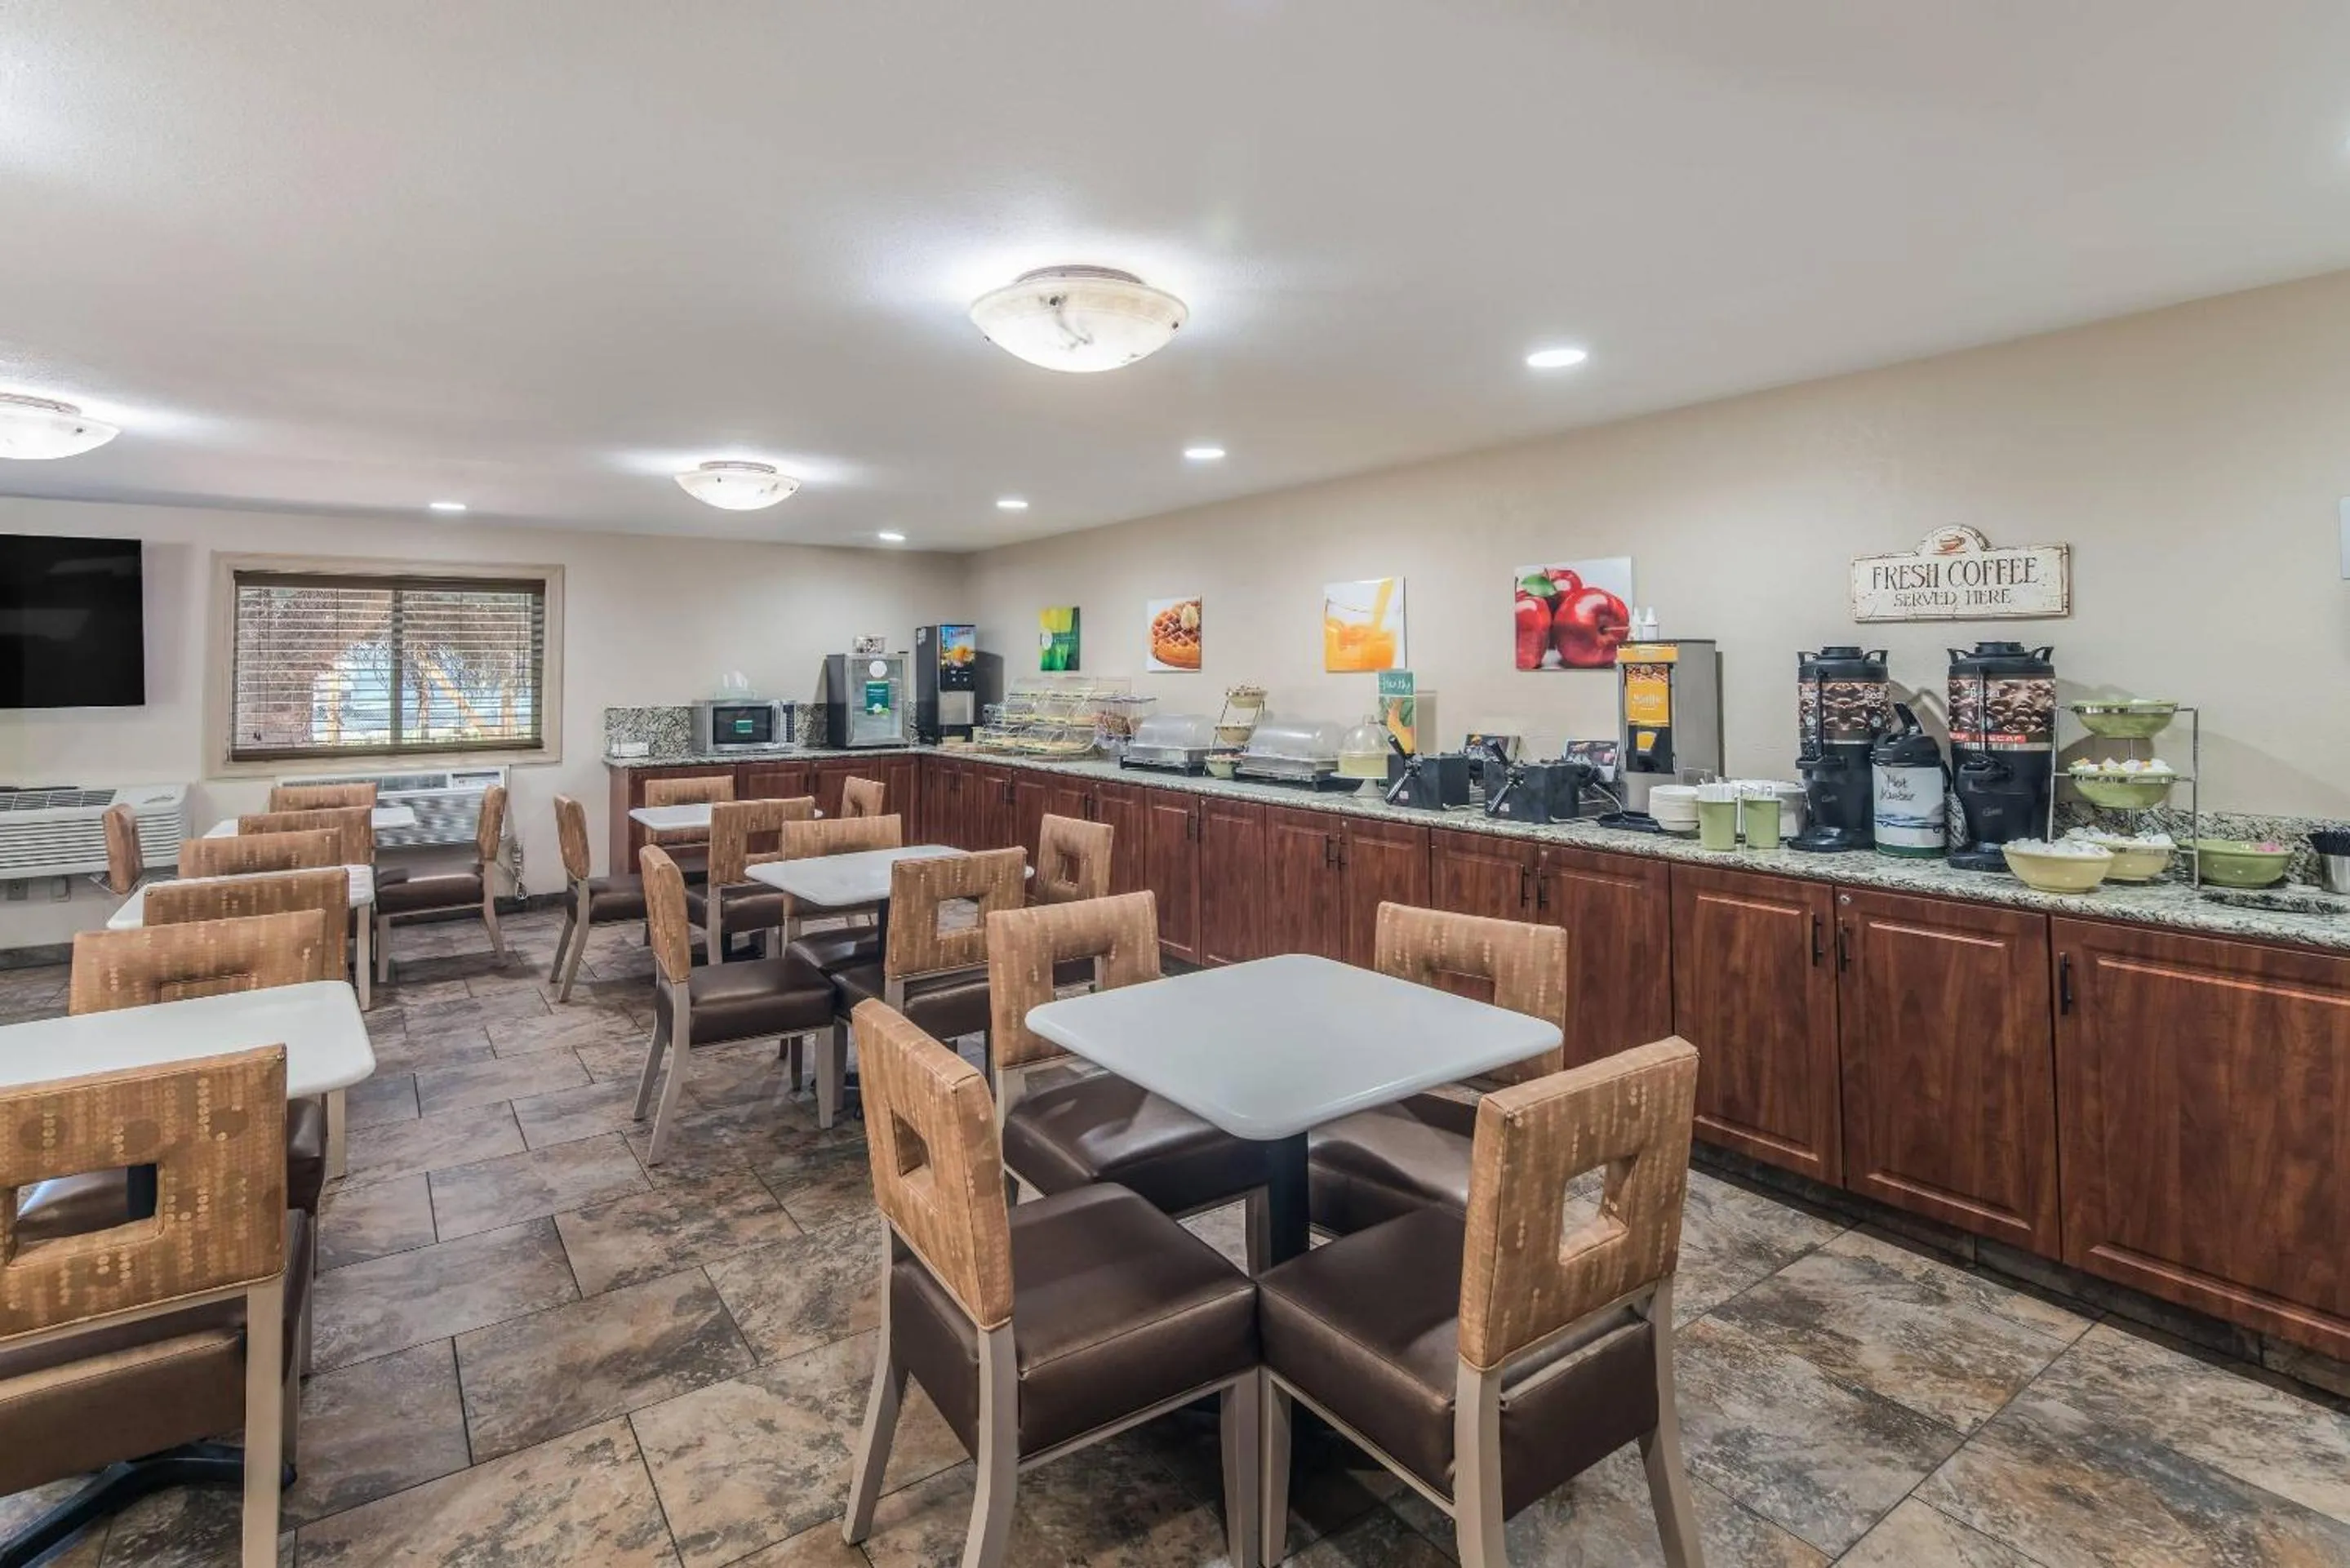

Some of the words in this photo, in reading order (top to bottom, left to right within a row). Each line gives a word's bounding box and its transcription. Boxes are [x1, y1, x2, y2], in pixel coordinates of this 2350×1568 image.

[1872, 563, 1940, 591] FRESH
[1948, 557, 2038, 586] COFFEE
[1894, 591, 1957, 607] SERVED
[1966, 589, 2012, 606] HERE
